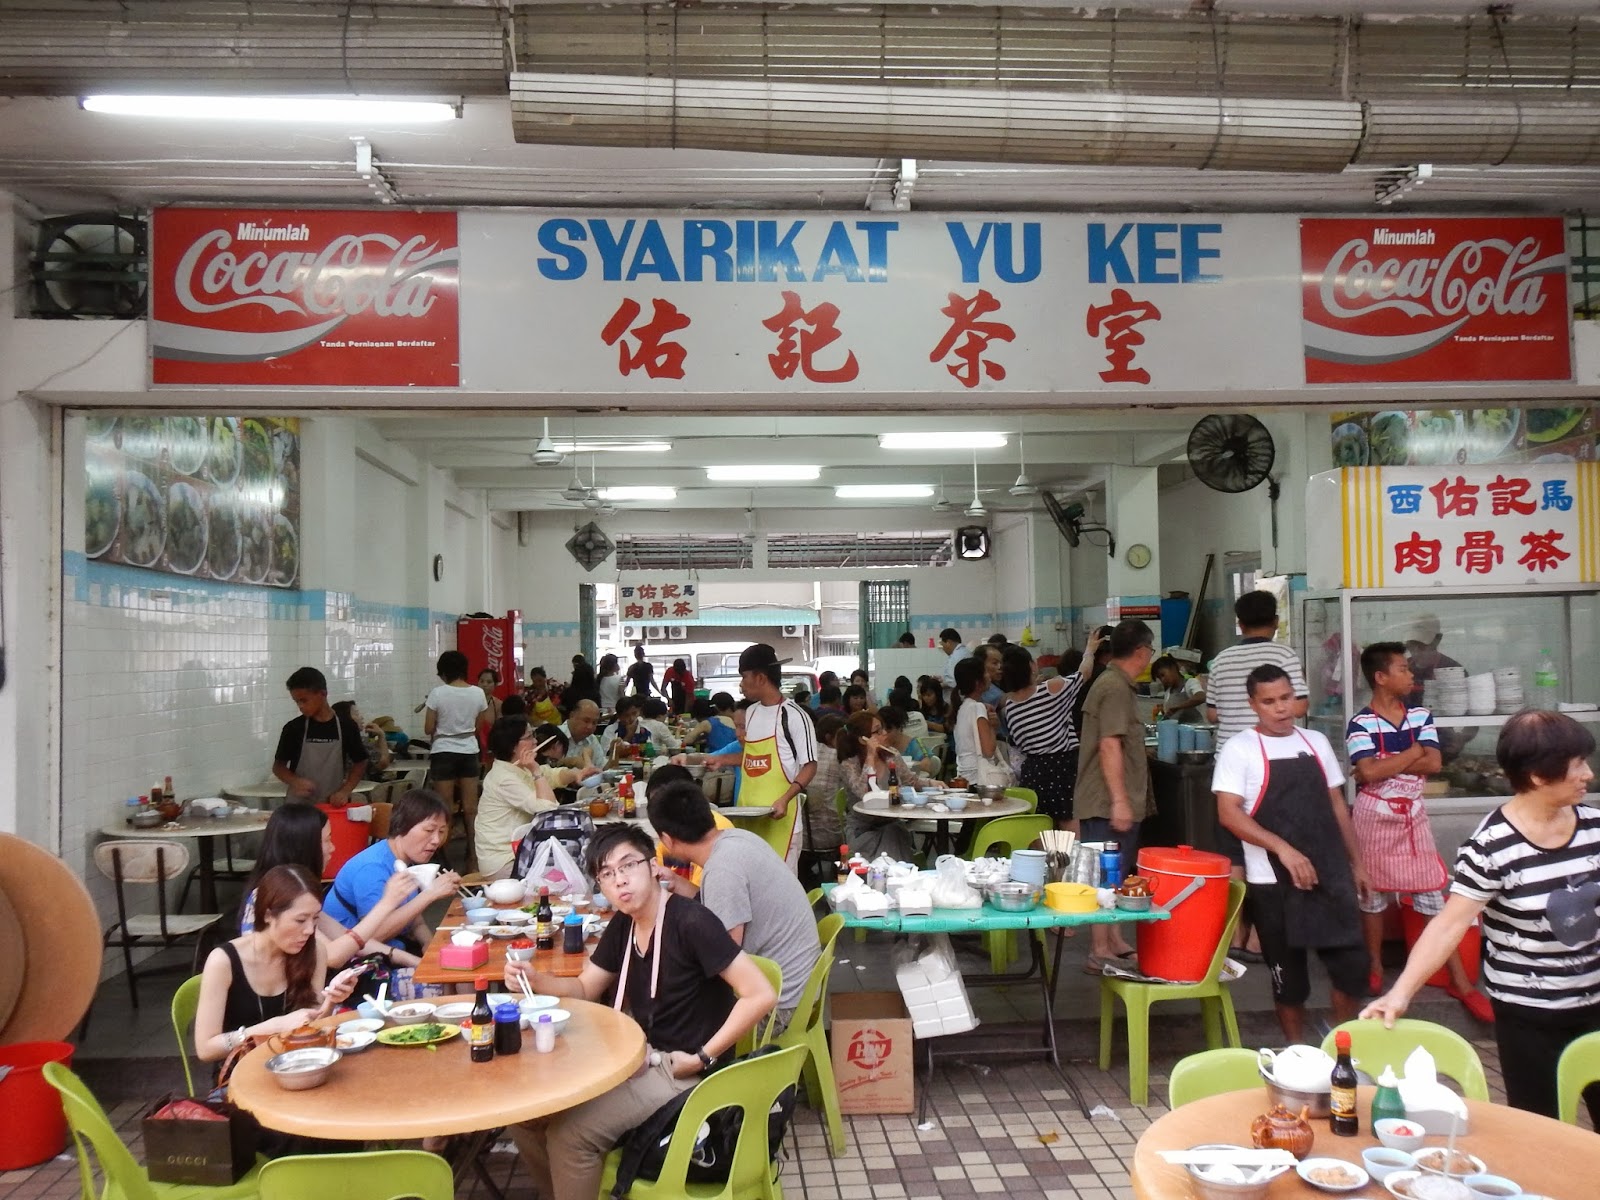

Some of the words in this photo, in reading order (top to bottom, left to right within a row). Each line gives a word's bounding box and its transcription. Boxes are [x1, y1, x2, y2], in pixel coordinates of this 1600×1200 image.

[237, 222, 310, 241] Minumlah
[1373, 228, 1436, 245] Minumlah
[537, 218, 899, 283] SYARIKAT
[946, 221, 1042, 283] YU
[1087, 223, 1224, 284] KEE
[175, 229, 440, 317] Coca-Cola
[1320, 236, 1548, 318] Coca-Cola
[320, 340, 346, 348] Tanda
[397, 340, 436, 348] Berdaftar
[601, 288, 1162, 388] 佑記茶室
[1393, 528, 1572, 575] 肉骨茶
[624, 601, 694, 618] 肉骨茶
[167, 1154, 207, 1166] GUCCI
